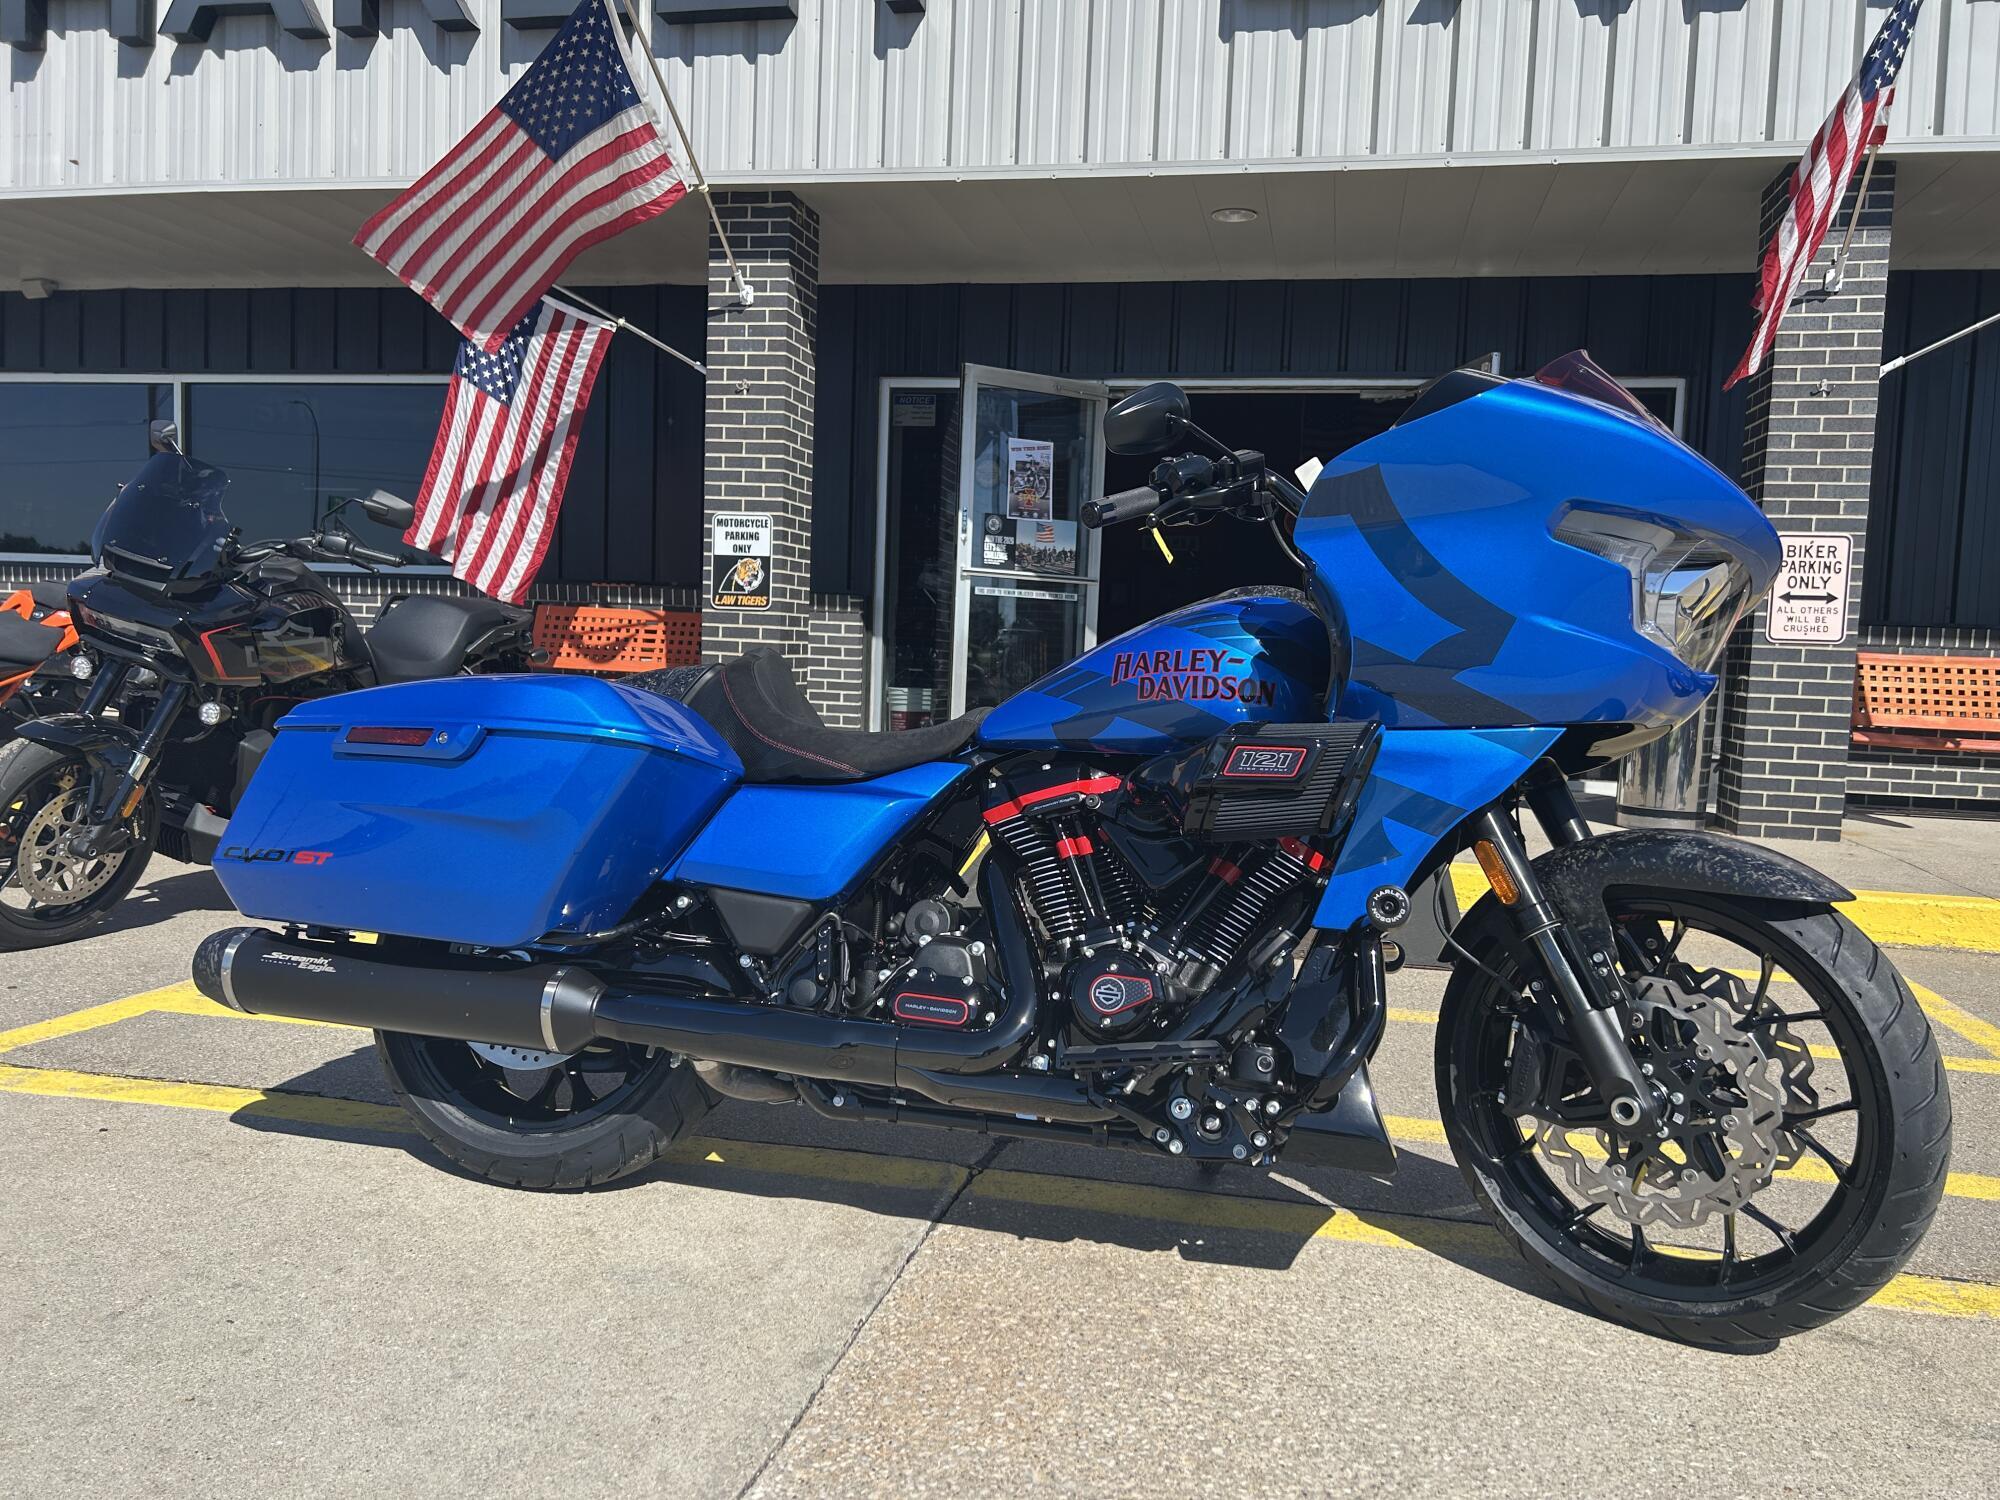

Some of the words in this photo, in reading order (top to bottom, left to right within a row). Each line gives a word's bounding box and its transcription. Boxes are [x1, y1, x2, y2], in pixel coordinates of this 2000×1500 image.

[716, 518, 769, 529] MOTORCYCLE
[725, 532, 760, 541] PARKING
[732, 544, 752, 554] ONLY
[1787, 544, 1838, 559] BIKER
[1780, 560, 1842, 575] PARKING
[1787, 575, 1832, 590] ONLY
[715, 594, 737, 605] LAW
[737, 595, 769, 607] TIGERS
[1777, 606, 1796, 614] ALL
[1800, 606, 1839, 615] OTHERS
[1786, 616, 1809, 624] WILL
[1814, 616, 1828, 624] BE
[1783, 624, 1829, 633] CRUSHED
[1111, 649, 1246, 687] HARLEY-
[1137, 675, 1277, 708] DAVIDSON
[1240, 751, 1293, 768] 121
[223, 846, 286, 863] CVO
[293, 850, 334, 865] ST
[1372, 889, 1405, 901] HARLEY
[1371, 908, 1406, 923] DAVIDSON
[262, 951, 332, 965] Screamin'
[297, 961, 337, 973] Eagle
